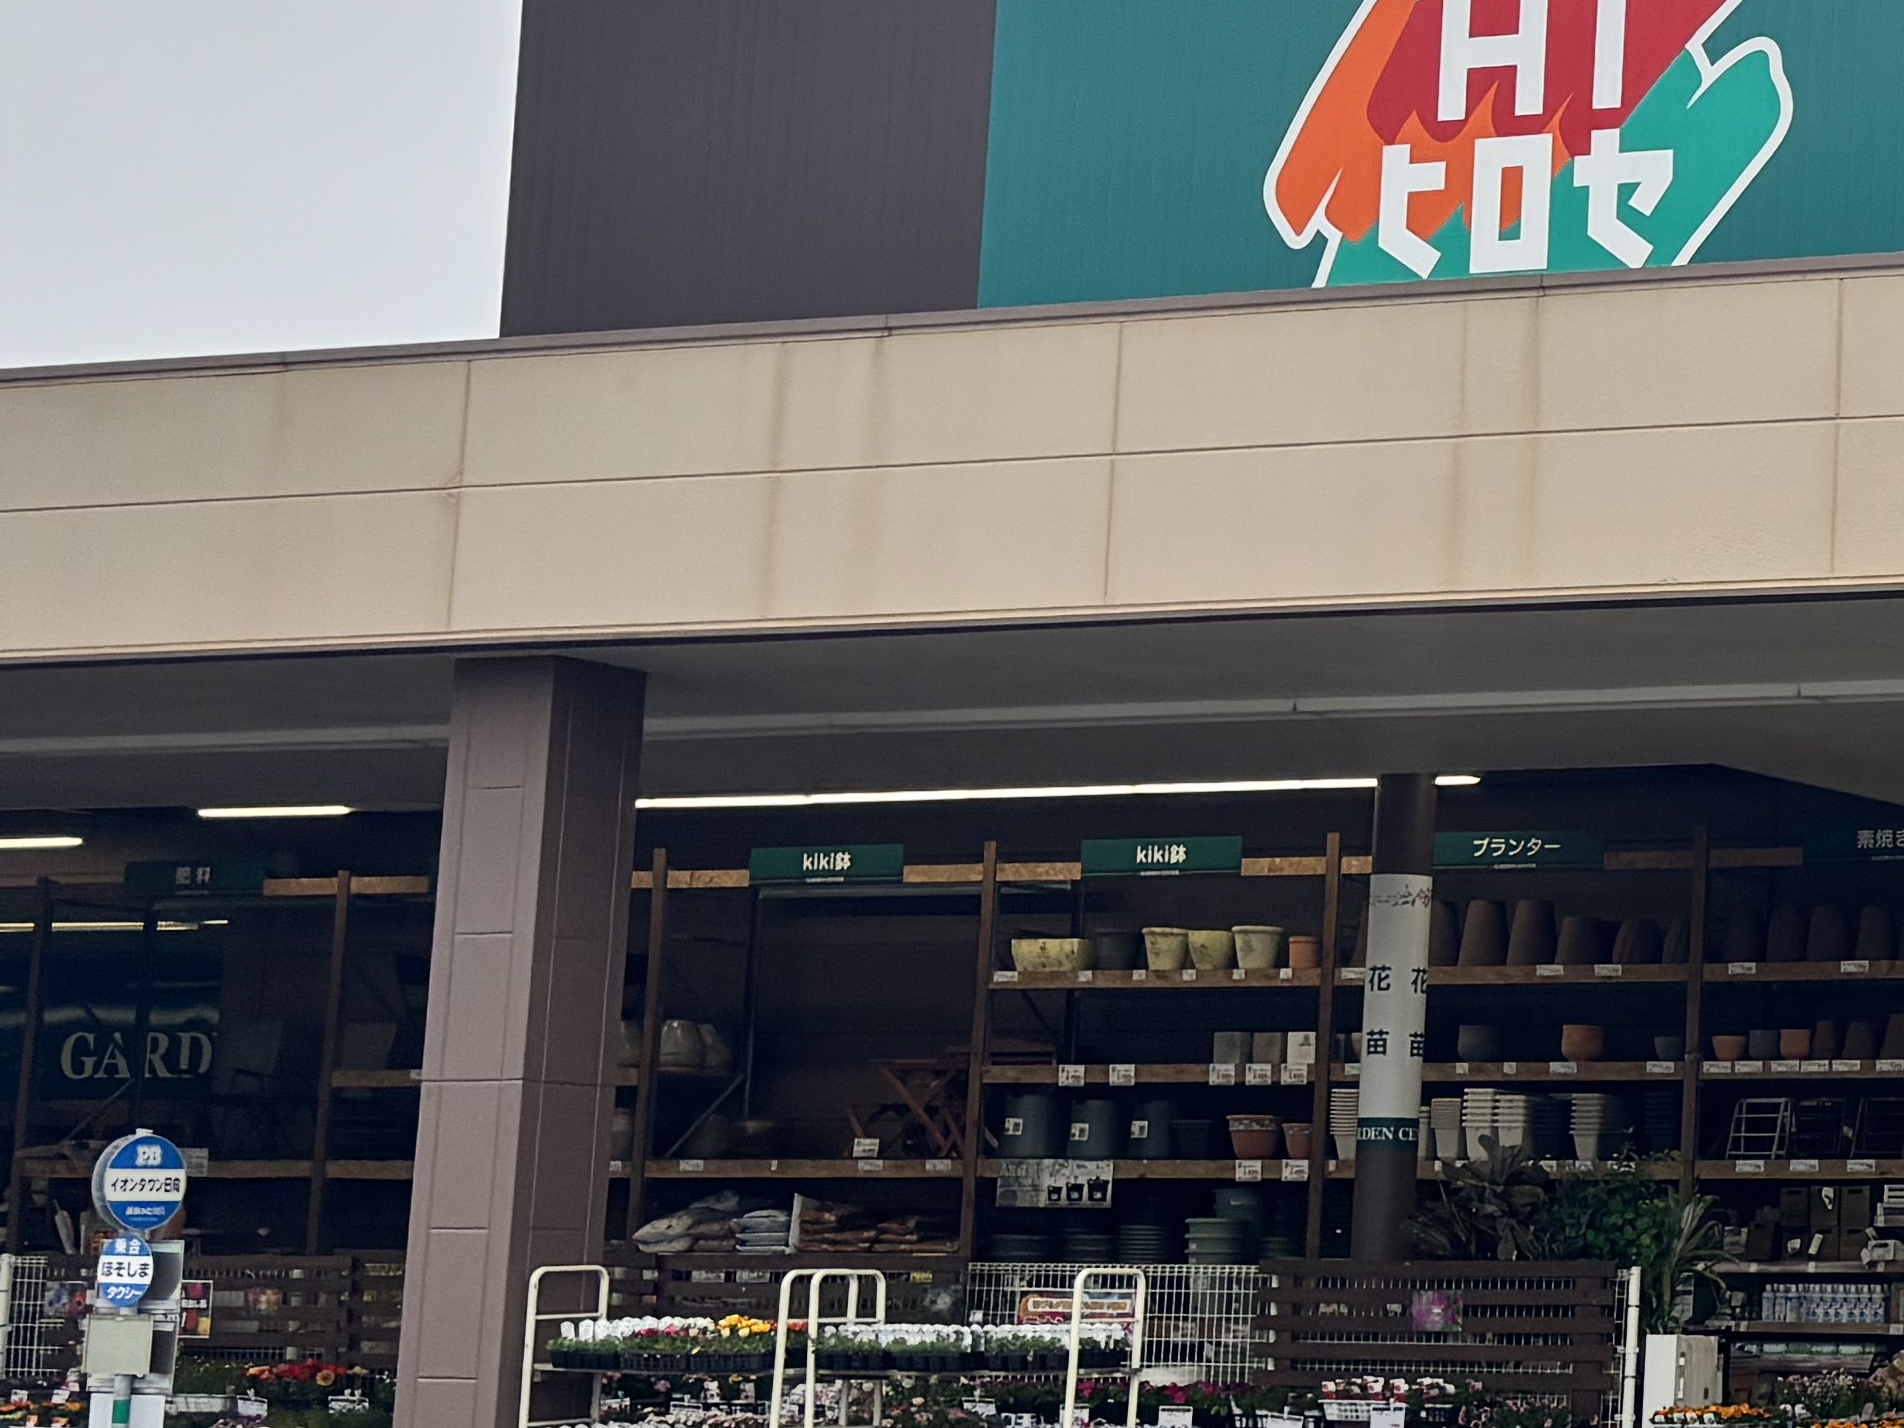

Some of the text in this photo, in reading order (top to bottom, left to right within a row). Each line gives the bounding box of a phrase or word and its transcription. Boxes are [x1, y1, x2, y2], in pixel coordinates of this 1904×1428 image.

[1378, 128, 1674, 279] ヒロセ
[1473, 837, 1561, 857] プランター
[111, 1176, 181, 1193] イオンタウン日向
[101, 1261, 150, 1278] ほそしま
[107, 1286, 143, 1300] タクシー
